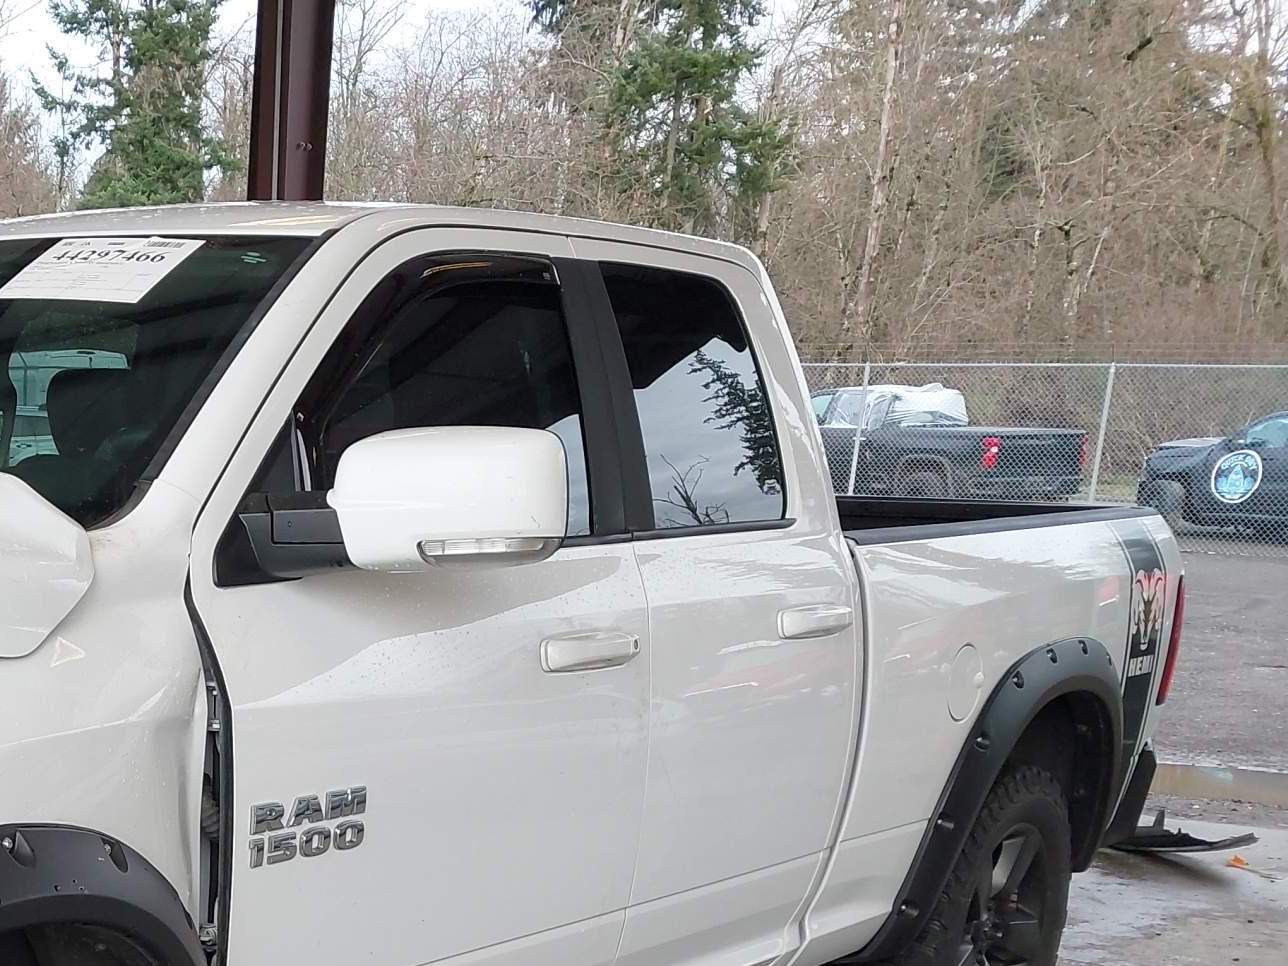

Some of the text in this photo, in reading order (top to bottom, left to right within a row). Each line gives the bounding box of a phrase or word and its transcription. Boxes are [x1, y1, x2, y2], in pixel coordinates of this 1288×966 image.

[53, 249, 168, 263] 44297466
[1128, 654, 1154, 678] HEMI
[249, 784, 368, 836] RAM
[248, 819, 365, 869] 1500
